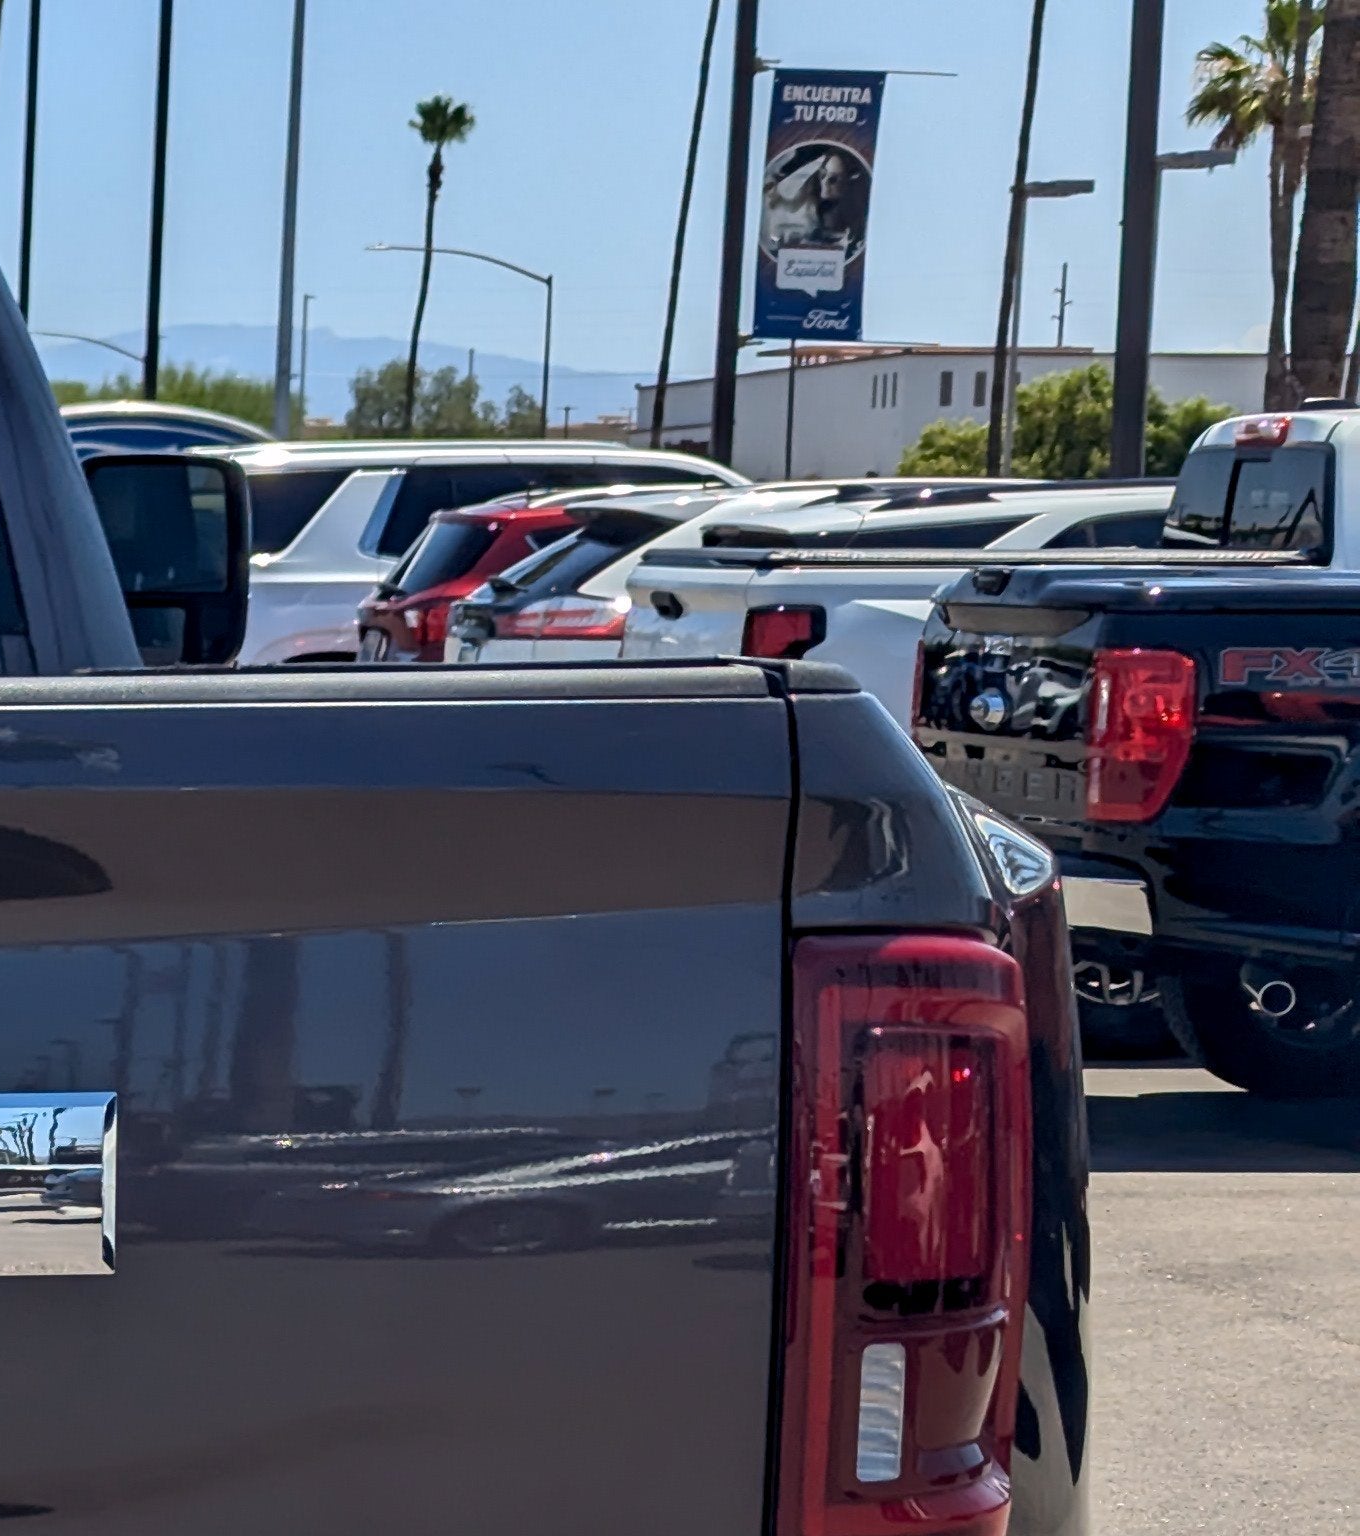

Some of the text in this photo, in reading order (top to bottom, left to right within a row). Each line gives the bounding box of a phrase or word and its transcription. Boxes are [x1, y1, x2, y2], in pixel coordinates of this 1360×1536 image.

[782, 85, 872, 104] ENCUENTRA
[794, 105, 858, 123] TU FORD
[802, 309, 850, 330] Ford
